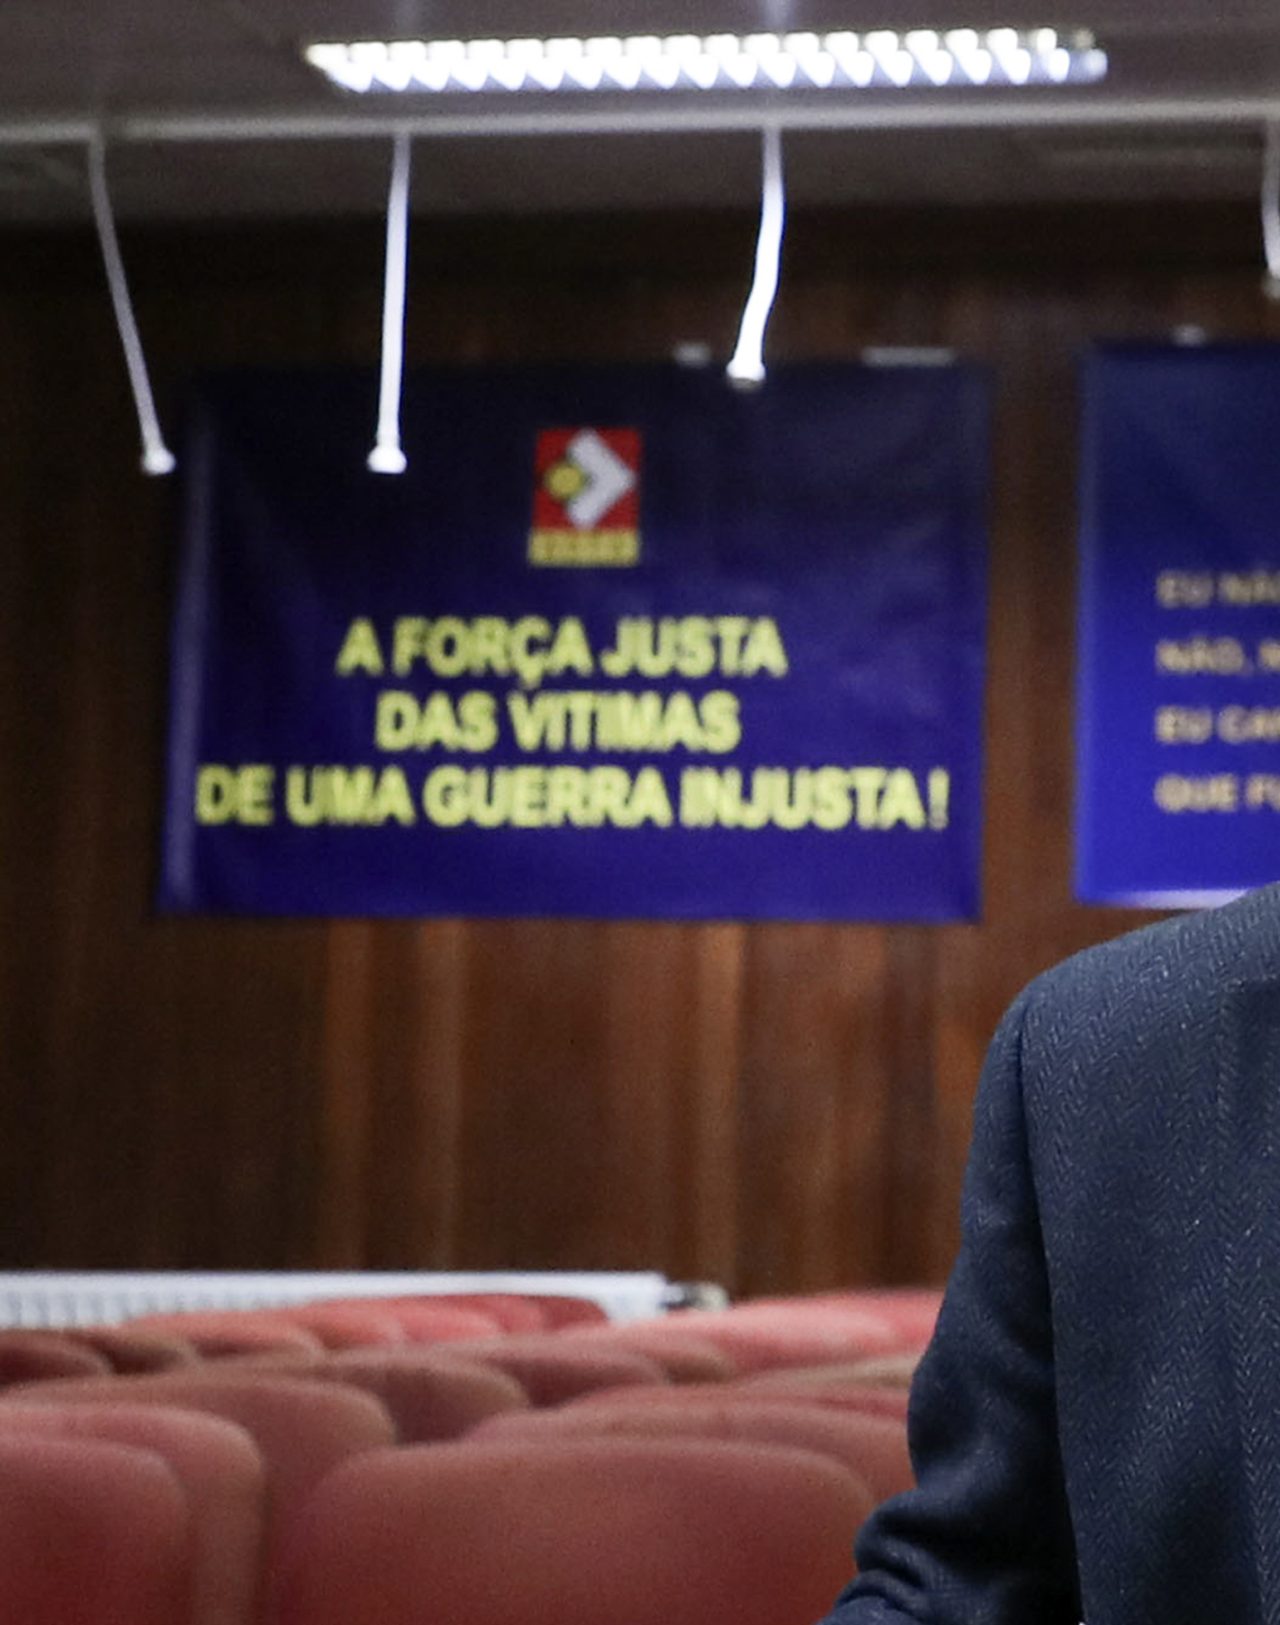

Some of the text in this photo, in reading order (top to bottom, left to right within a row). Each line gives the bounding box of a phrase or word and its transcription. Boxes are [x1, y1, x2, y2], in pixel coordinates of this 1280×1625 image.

[336, 617, 789, 690] A FORÇA JUSTA
[374, 691, 742, 753] DAS VITIMAS
[195, 765, 950, 830] DE UMA GUERRA INJUSTA!
[1154, 773, 1239, 813] QUE
